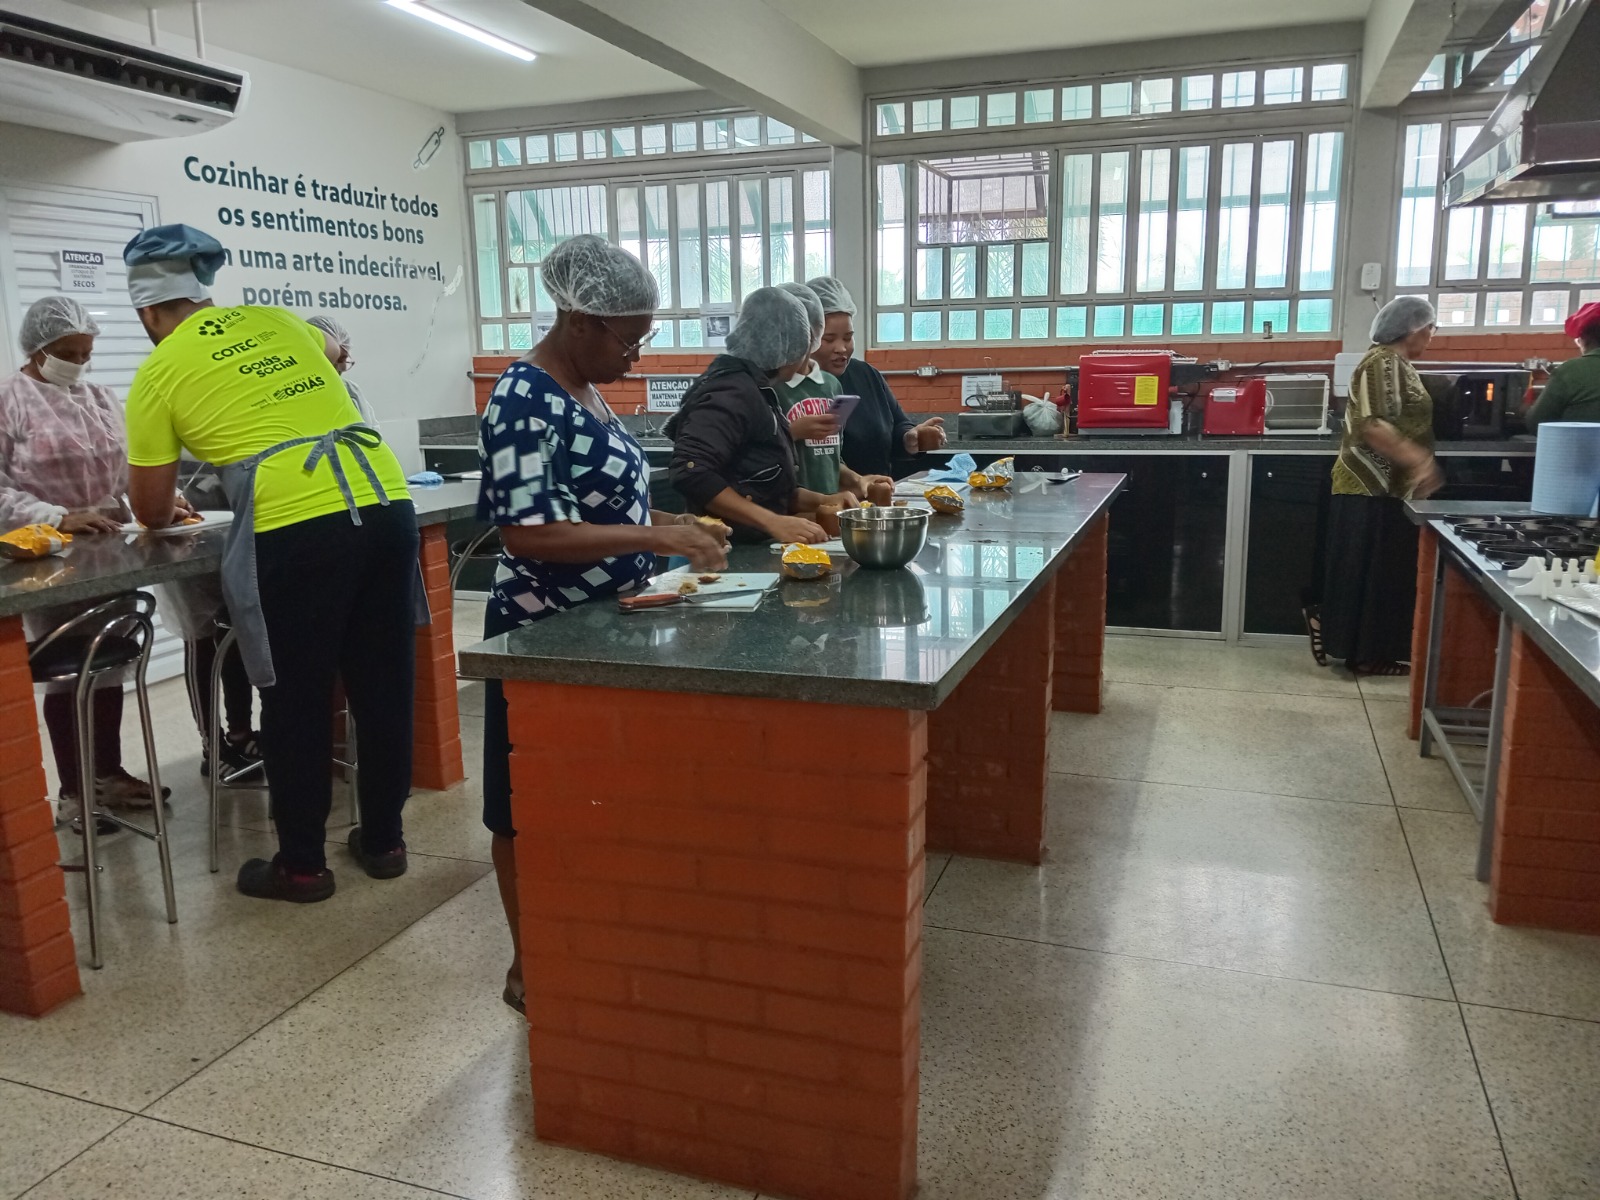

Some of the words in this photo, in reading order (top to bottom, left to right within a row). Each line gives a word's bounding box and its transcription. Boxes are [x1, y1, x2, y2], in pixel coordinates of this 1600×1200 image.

[184, 156, 289, 195] Cozinhar
[294, 173, 306, 198] é
[311, 179, 386, 210] traduzir
[390, 193, 439, 218] todos
[218, 207, 245, 227] os
[251, 208, 378, 240] sentimentos
[382, 220, 424, 244] bons
[65, 253, 101, 264] ATENÇÃO
[239, 249, 287, 270] uma
[292, 252, 334, 273] arte
[73, 280, 95, 288] SECOS
[243, 282, 313, 307] porém
[318, 287, 407, 311] saborosa.
[216, 311, 242, 324] UFG
[212, 338, 258, 361] COTEC
[239, 355, 281, 375] Goiás
[256, 355, 298, 378] social
[284, 376, 325, 397] GOIÁS
[652, 392, 677, 400] MANTENHA
[656, 400, 671, 408] LOCAL
